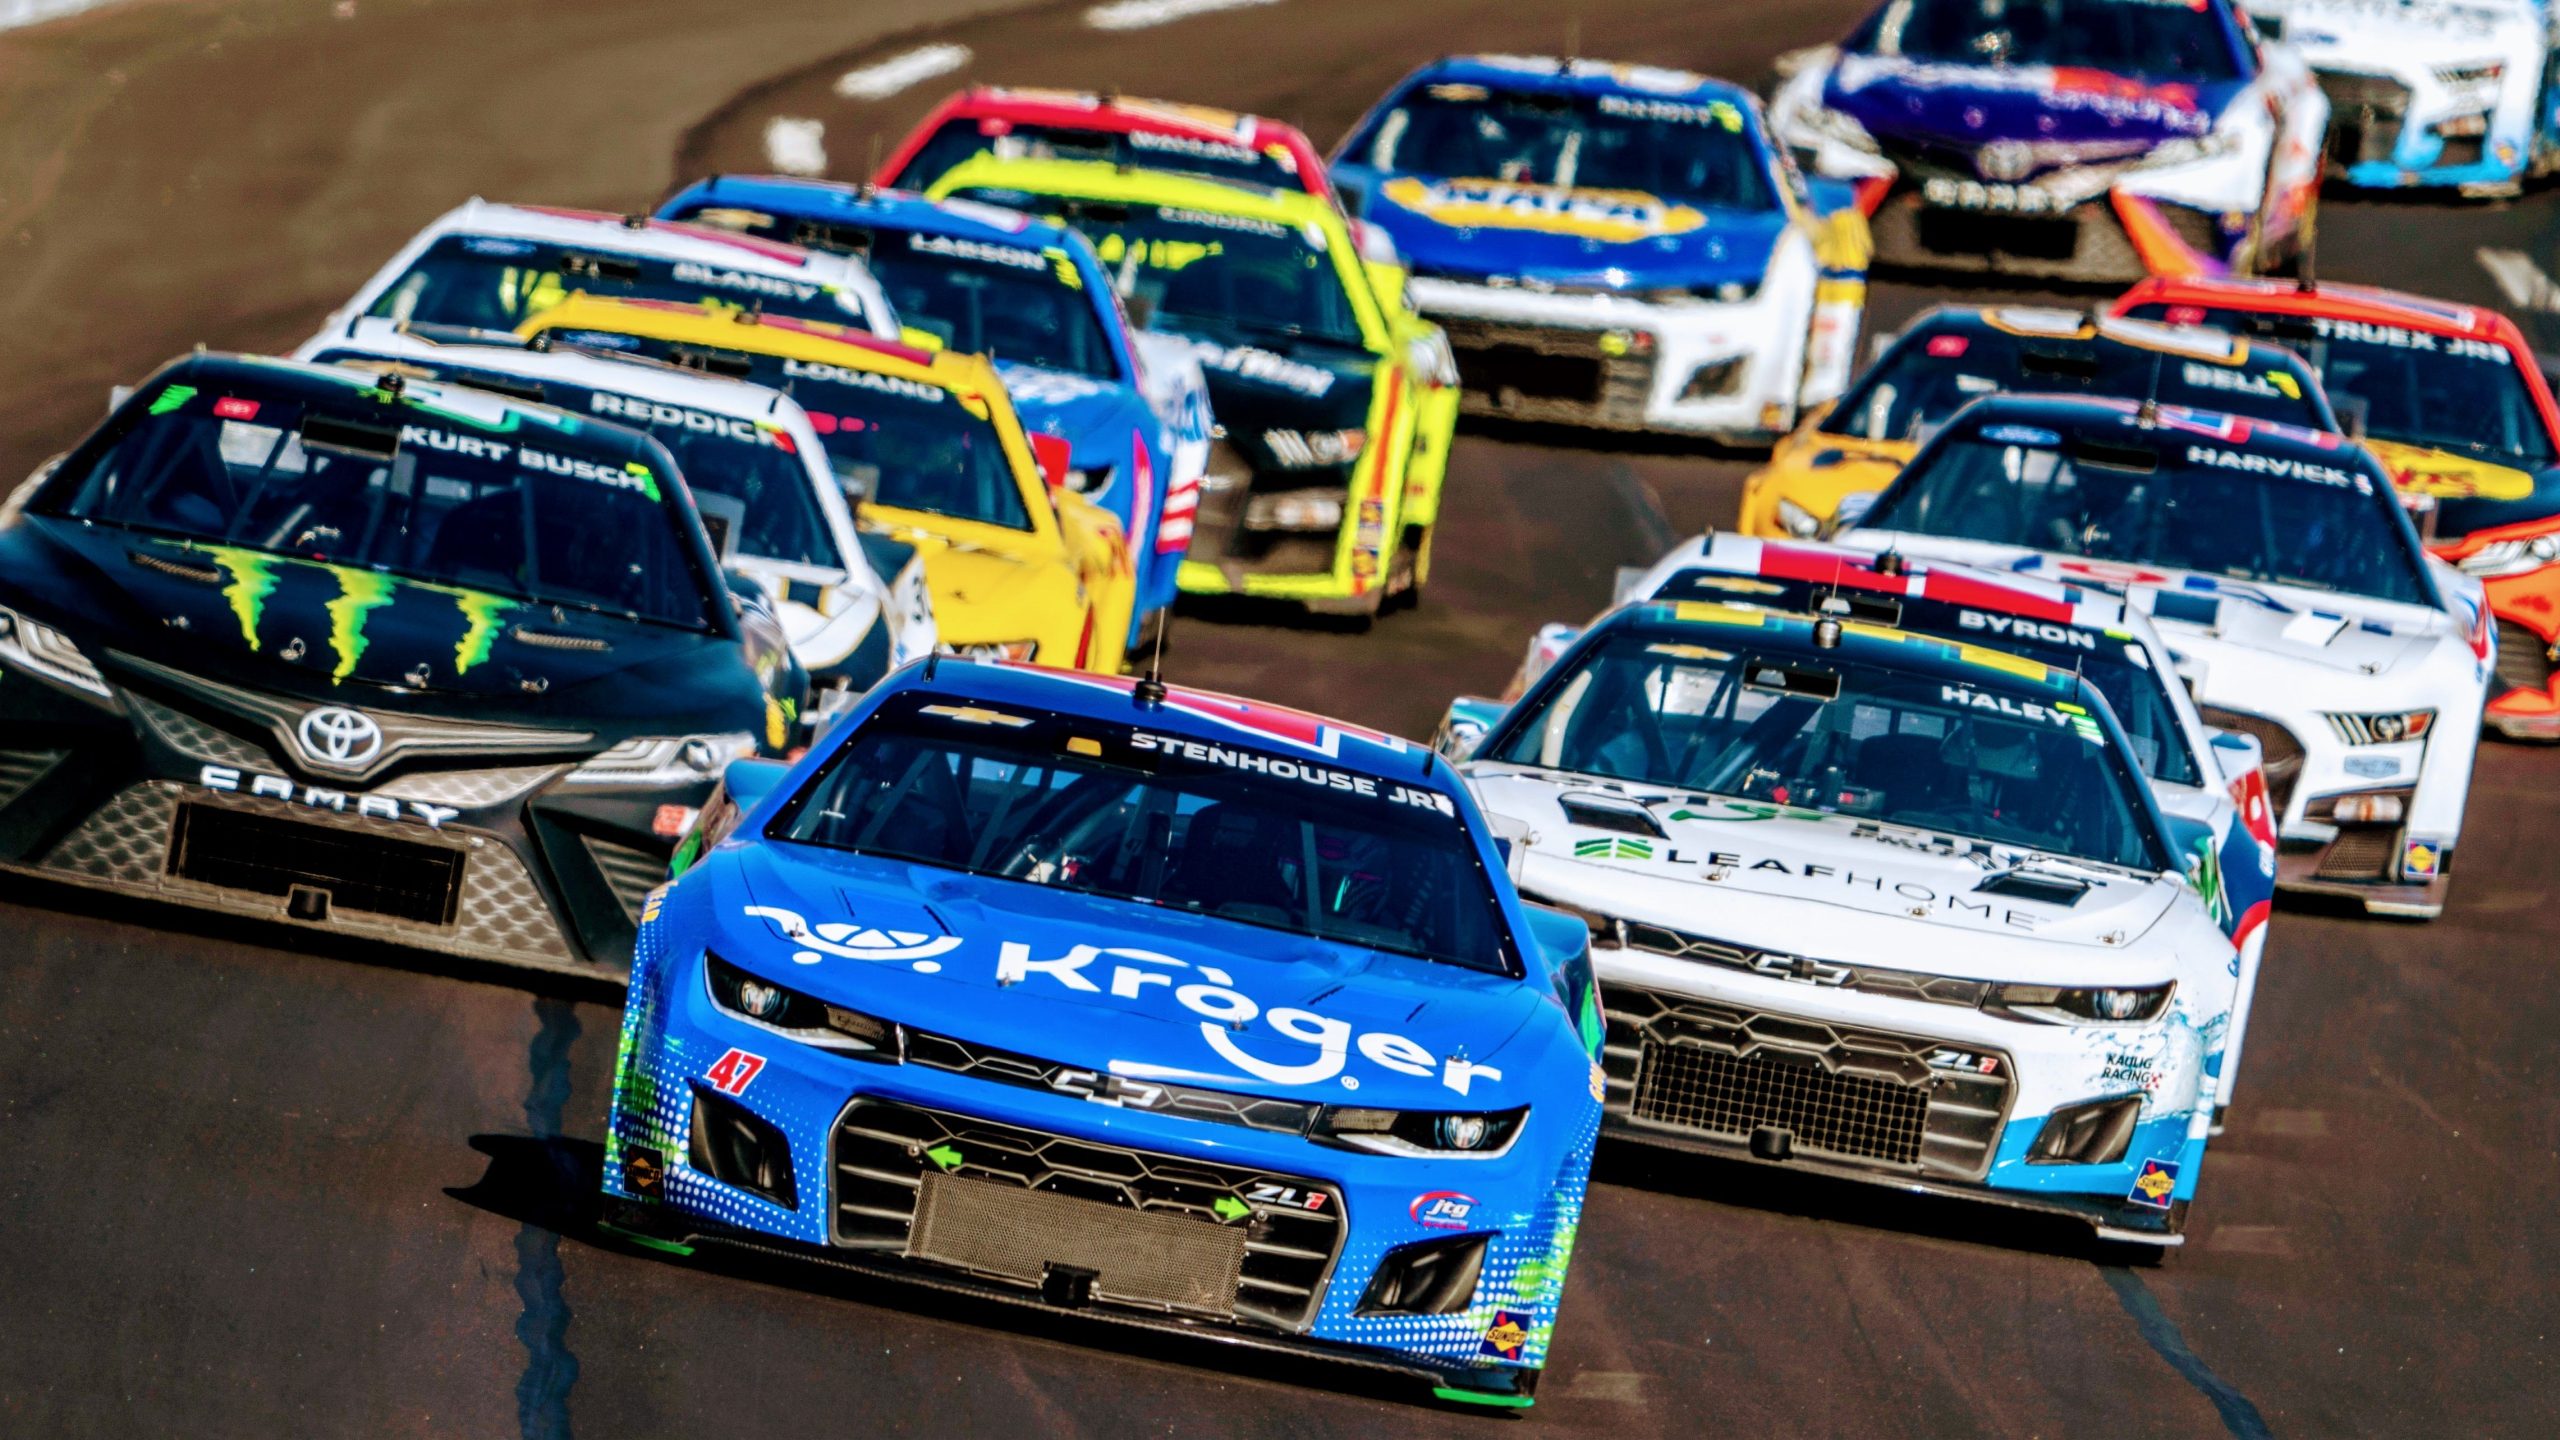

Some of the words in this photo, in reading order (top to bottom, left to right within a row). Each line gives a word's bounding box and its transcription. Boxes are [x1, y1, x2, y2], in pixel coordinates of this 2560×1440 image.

[672, 261, 818, 301] BLANEY
[2311, 317, 2437, 351] TRUEX
[782, 358, 944, 402] LOGANO
[2183, 362, 2281, 397] BELL
[401, 424, 511, 461] KURT
[518, 447, 646, 492] BUSCH
[2186, 445, 2350, 488] HARVICK
[1958, 609, 2096, 650] BYRON
[1941, 685, 2071, 727] HALEY
[1130, 733, 1378, 797] STENHOUSE
[200, 764, 459, 828] CAMRY
[996, 941, 1502, 1096] Kroger
[705, 1047, 768, 1097] 47
[1925, 1050, 1998, 1074] ZL1
[2101, 1067, 2151, 1083] RACING
[2106, 1052, 2153, 1069] KAULIG
[1246, 1182, 1328, 1210] ZL1
[1486, 1327, 1527, 1345] SUNOCO
